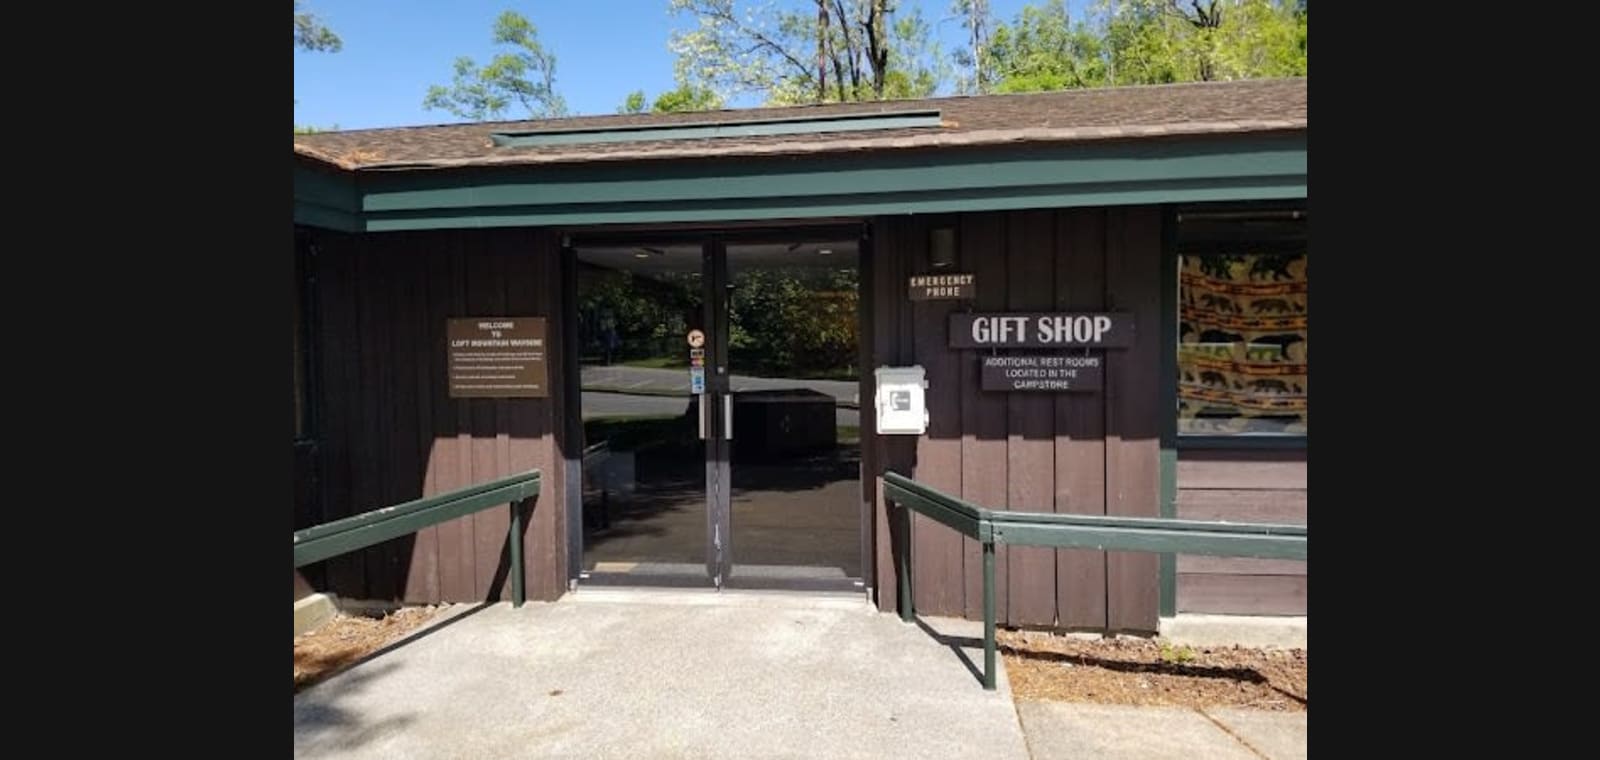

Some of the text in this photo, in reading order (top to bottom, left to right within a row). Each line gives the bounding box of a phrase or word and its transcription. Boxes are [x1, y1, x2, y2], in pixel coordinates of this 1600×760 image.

[911, 275, 973, 287] EMERGENCY
[927, 287, 960, 296] PHONE
[972, 315, 1112, 343] GIFT SHOP
[985, 357, 1099, 367] ADDITIONAL REST ROOMS
[1006, 369, 1077, 377] LOCATED IN THE
[1014, 380, 1068, 389] CAMPSTORE
